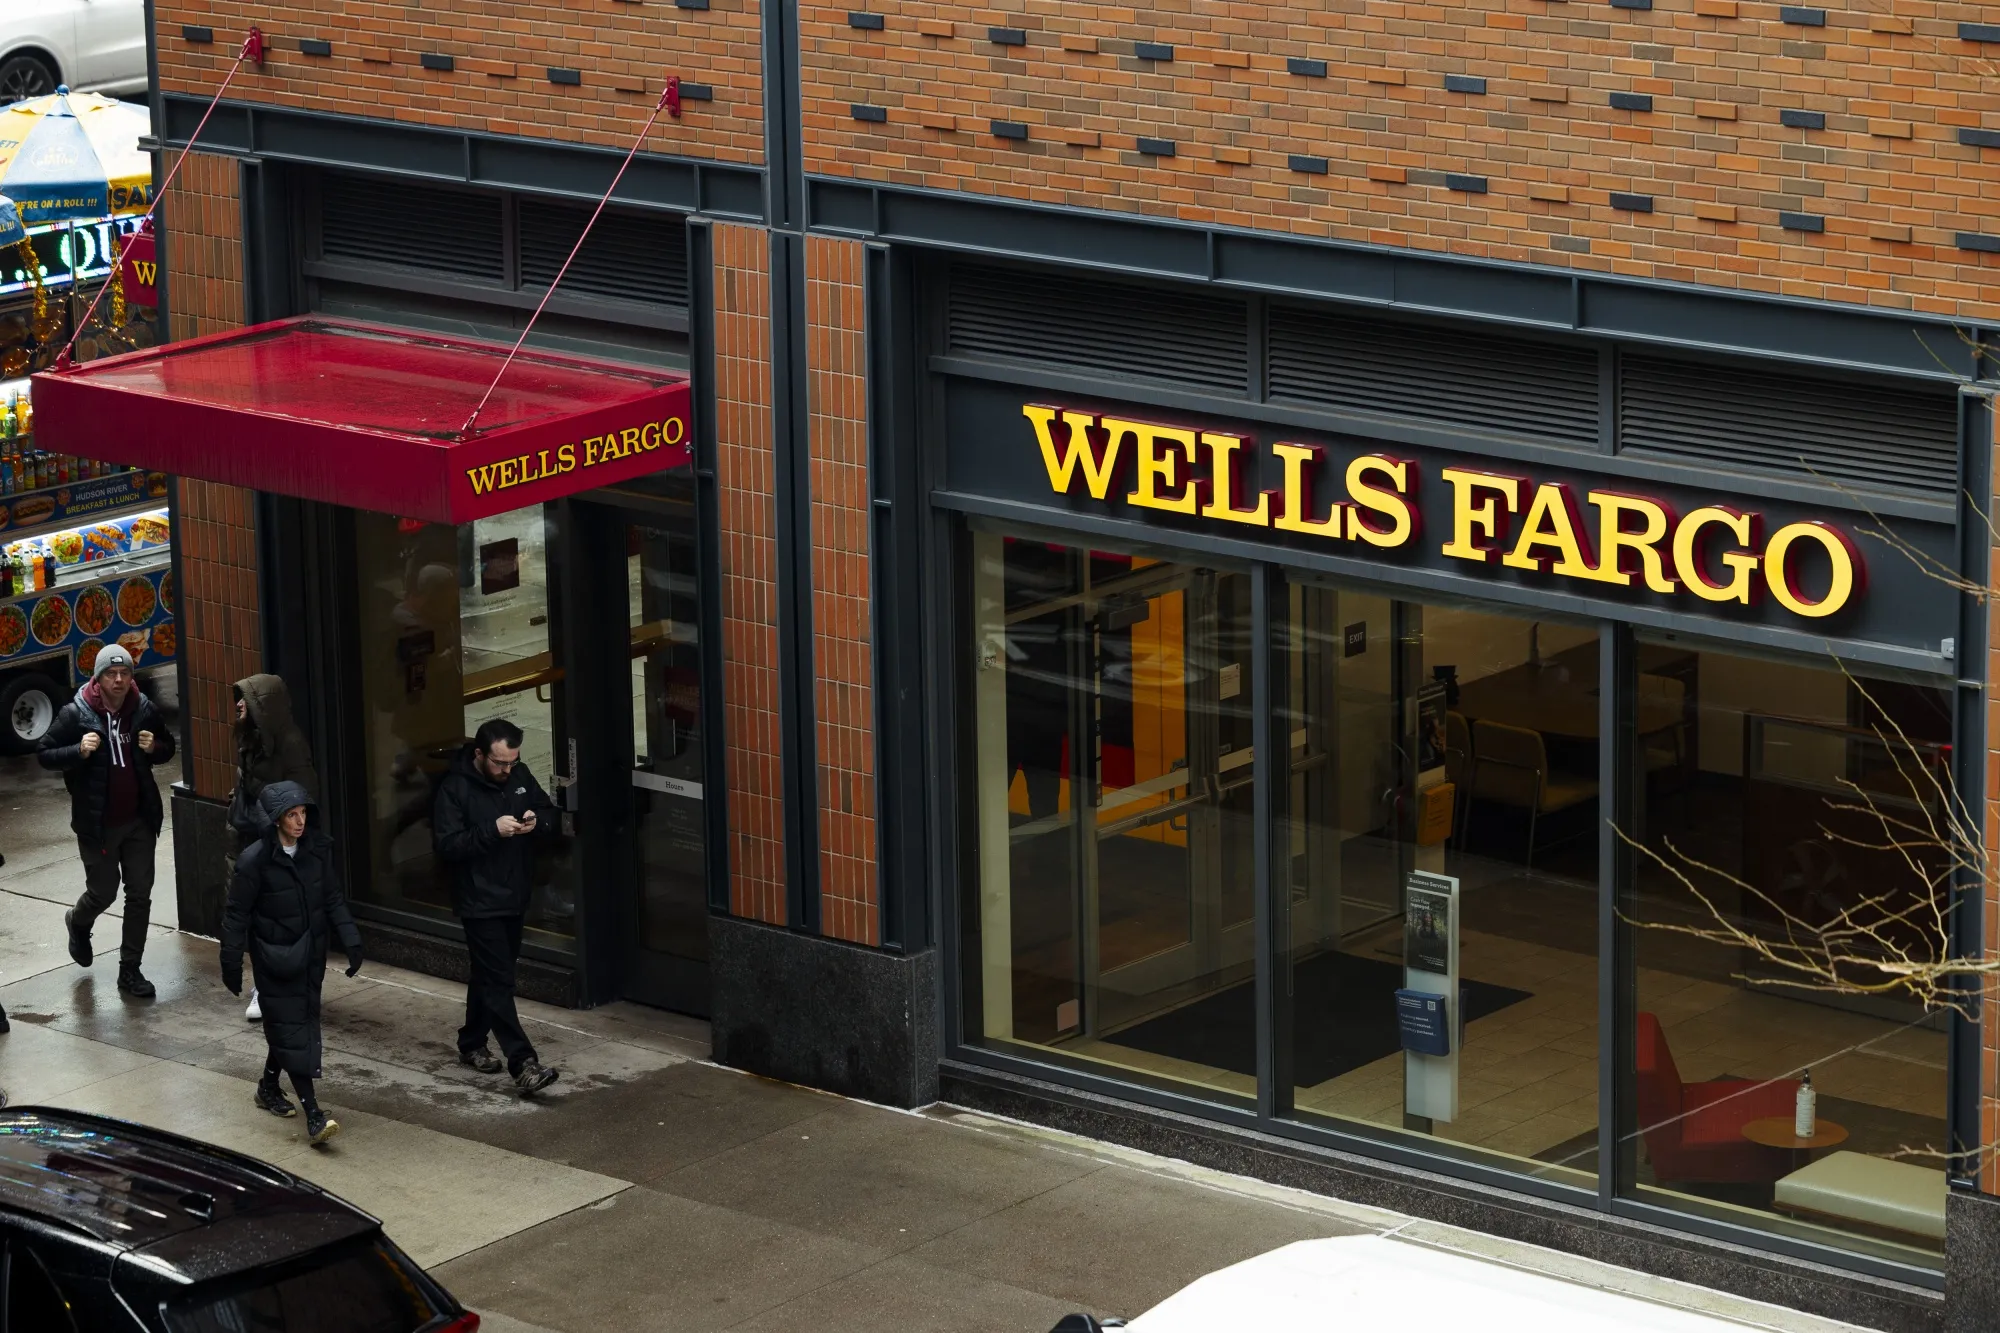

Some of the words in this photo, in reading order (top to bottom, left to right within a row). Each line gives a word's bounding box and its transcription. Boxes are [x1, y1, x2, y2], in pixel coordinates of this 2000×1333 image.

[41, 199, 53, 208] ON
[55, 199, 61, 208] A
[64, 198, 84, 207] ROLL
[466, 443, 576, 495] WELLS
[582, 416, 684, 467] FARGO
[75, 488, 105, 502] HUDSON
[106, 483, 128, 495] RIVER
[66, 498, 107, 514] BREAKFAST
[115, 492, 140, 505] LUNCH
[1022, 403, 1417, 548] WELLS
[1442, 466, 1859, 617] FARGO
[1349, 631, 1364, 644] EXIT
[665, 780, 685, 792] Hours
[1408, 877, 1429, 887] Business
[1429, 880, 1450, 890] Services
